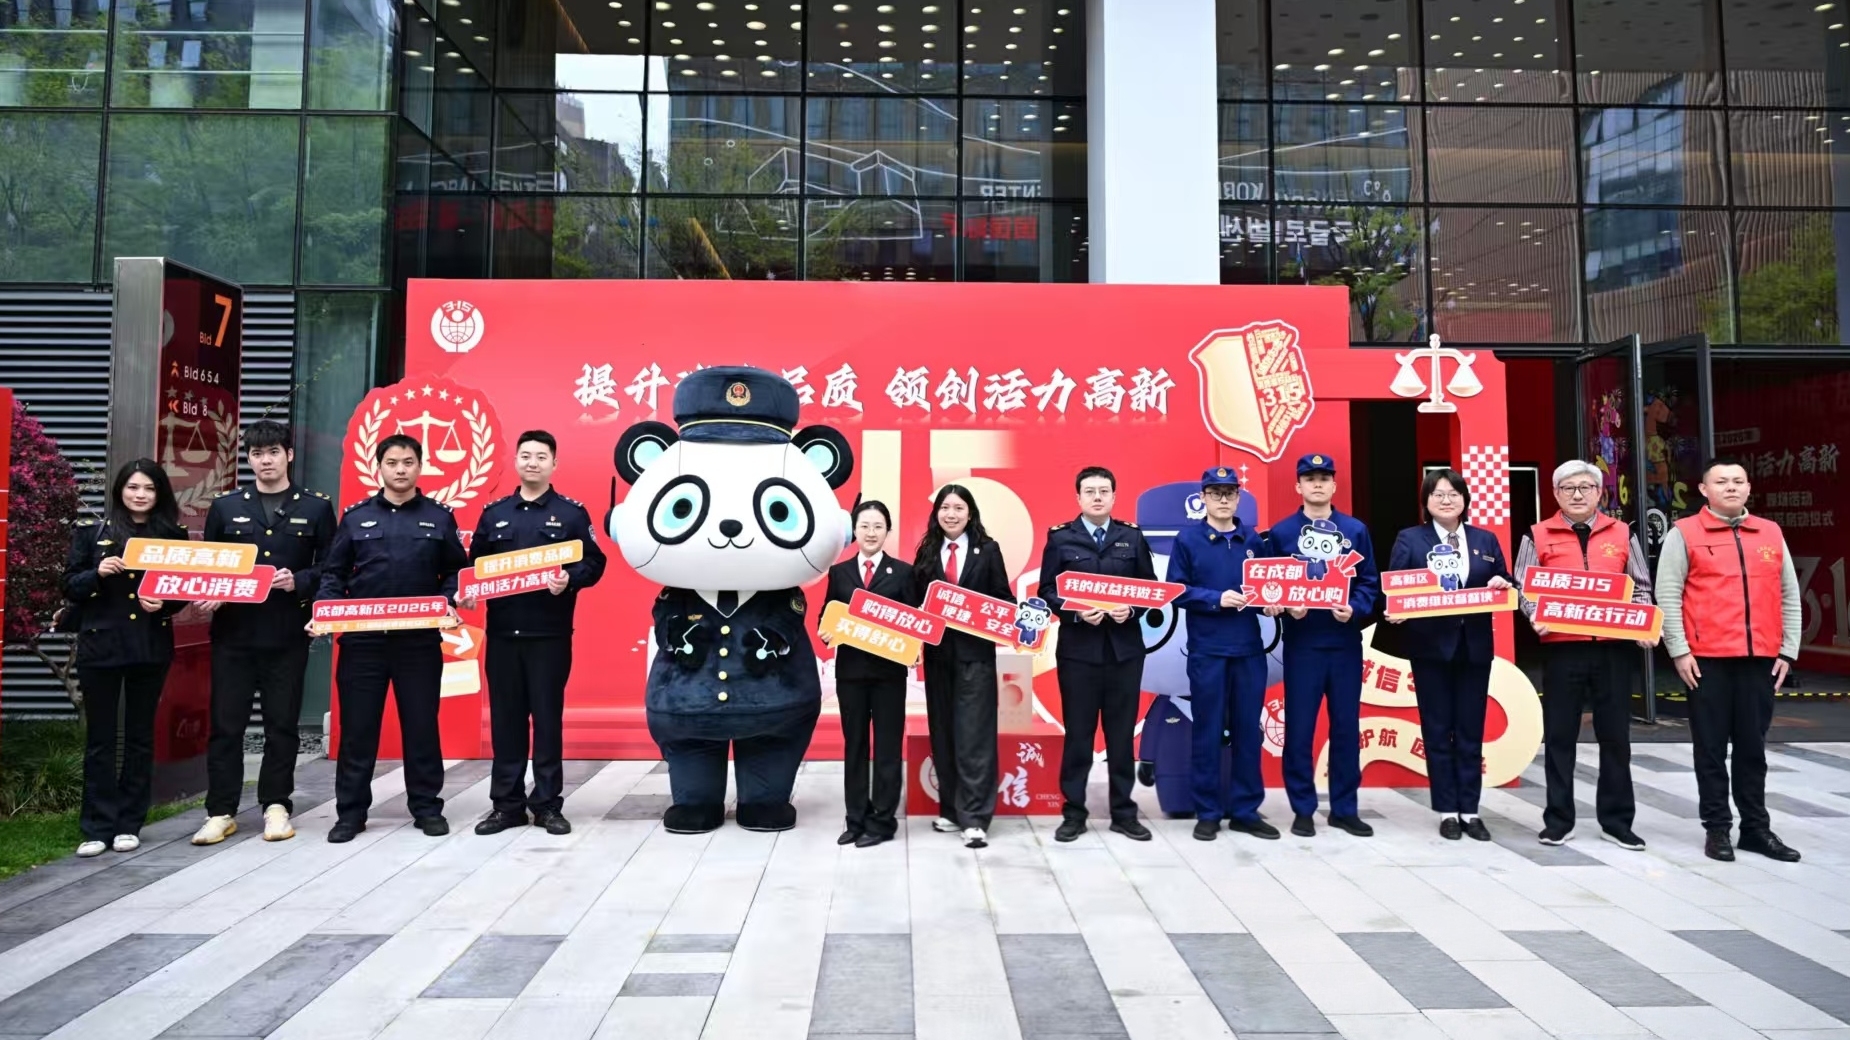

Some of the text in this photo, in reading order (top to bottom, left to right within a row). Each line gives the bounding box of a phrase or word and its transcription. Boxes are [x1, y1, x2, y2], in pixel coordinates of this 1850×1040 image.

[199, 294, 233, 348] Bld 7
[184, 365, 199, 380] Bld
[572, 362, 1177, 415] 提升品质 领创活力高新
[1262, 382, 1302, 407] 315
[182, 400, 209, 417] Bld 8
[138, 544, 244, 568] 品质高新
[483, 546, 574, 574] 提升消费品质
[1249, 563, 1304, 581] 在成都
[1390, 573, 1429, 586] 高新区
[1530, 571, 1612, 592] 品质315
[154, 574, 260, 598] 放心消费
[1064, 578, 1167, 602] 我的权益我做主
[1287, 585, 1344, 603] 放心购
[316, 600, 444, 618] 成都高新区2026年
[859, 599, 934, 636] 购得放心
[1543, 601, 1648, 627] 高新在行动
[835, 617, 906, 654] 买得舒心
